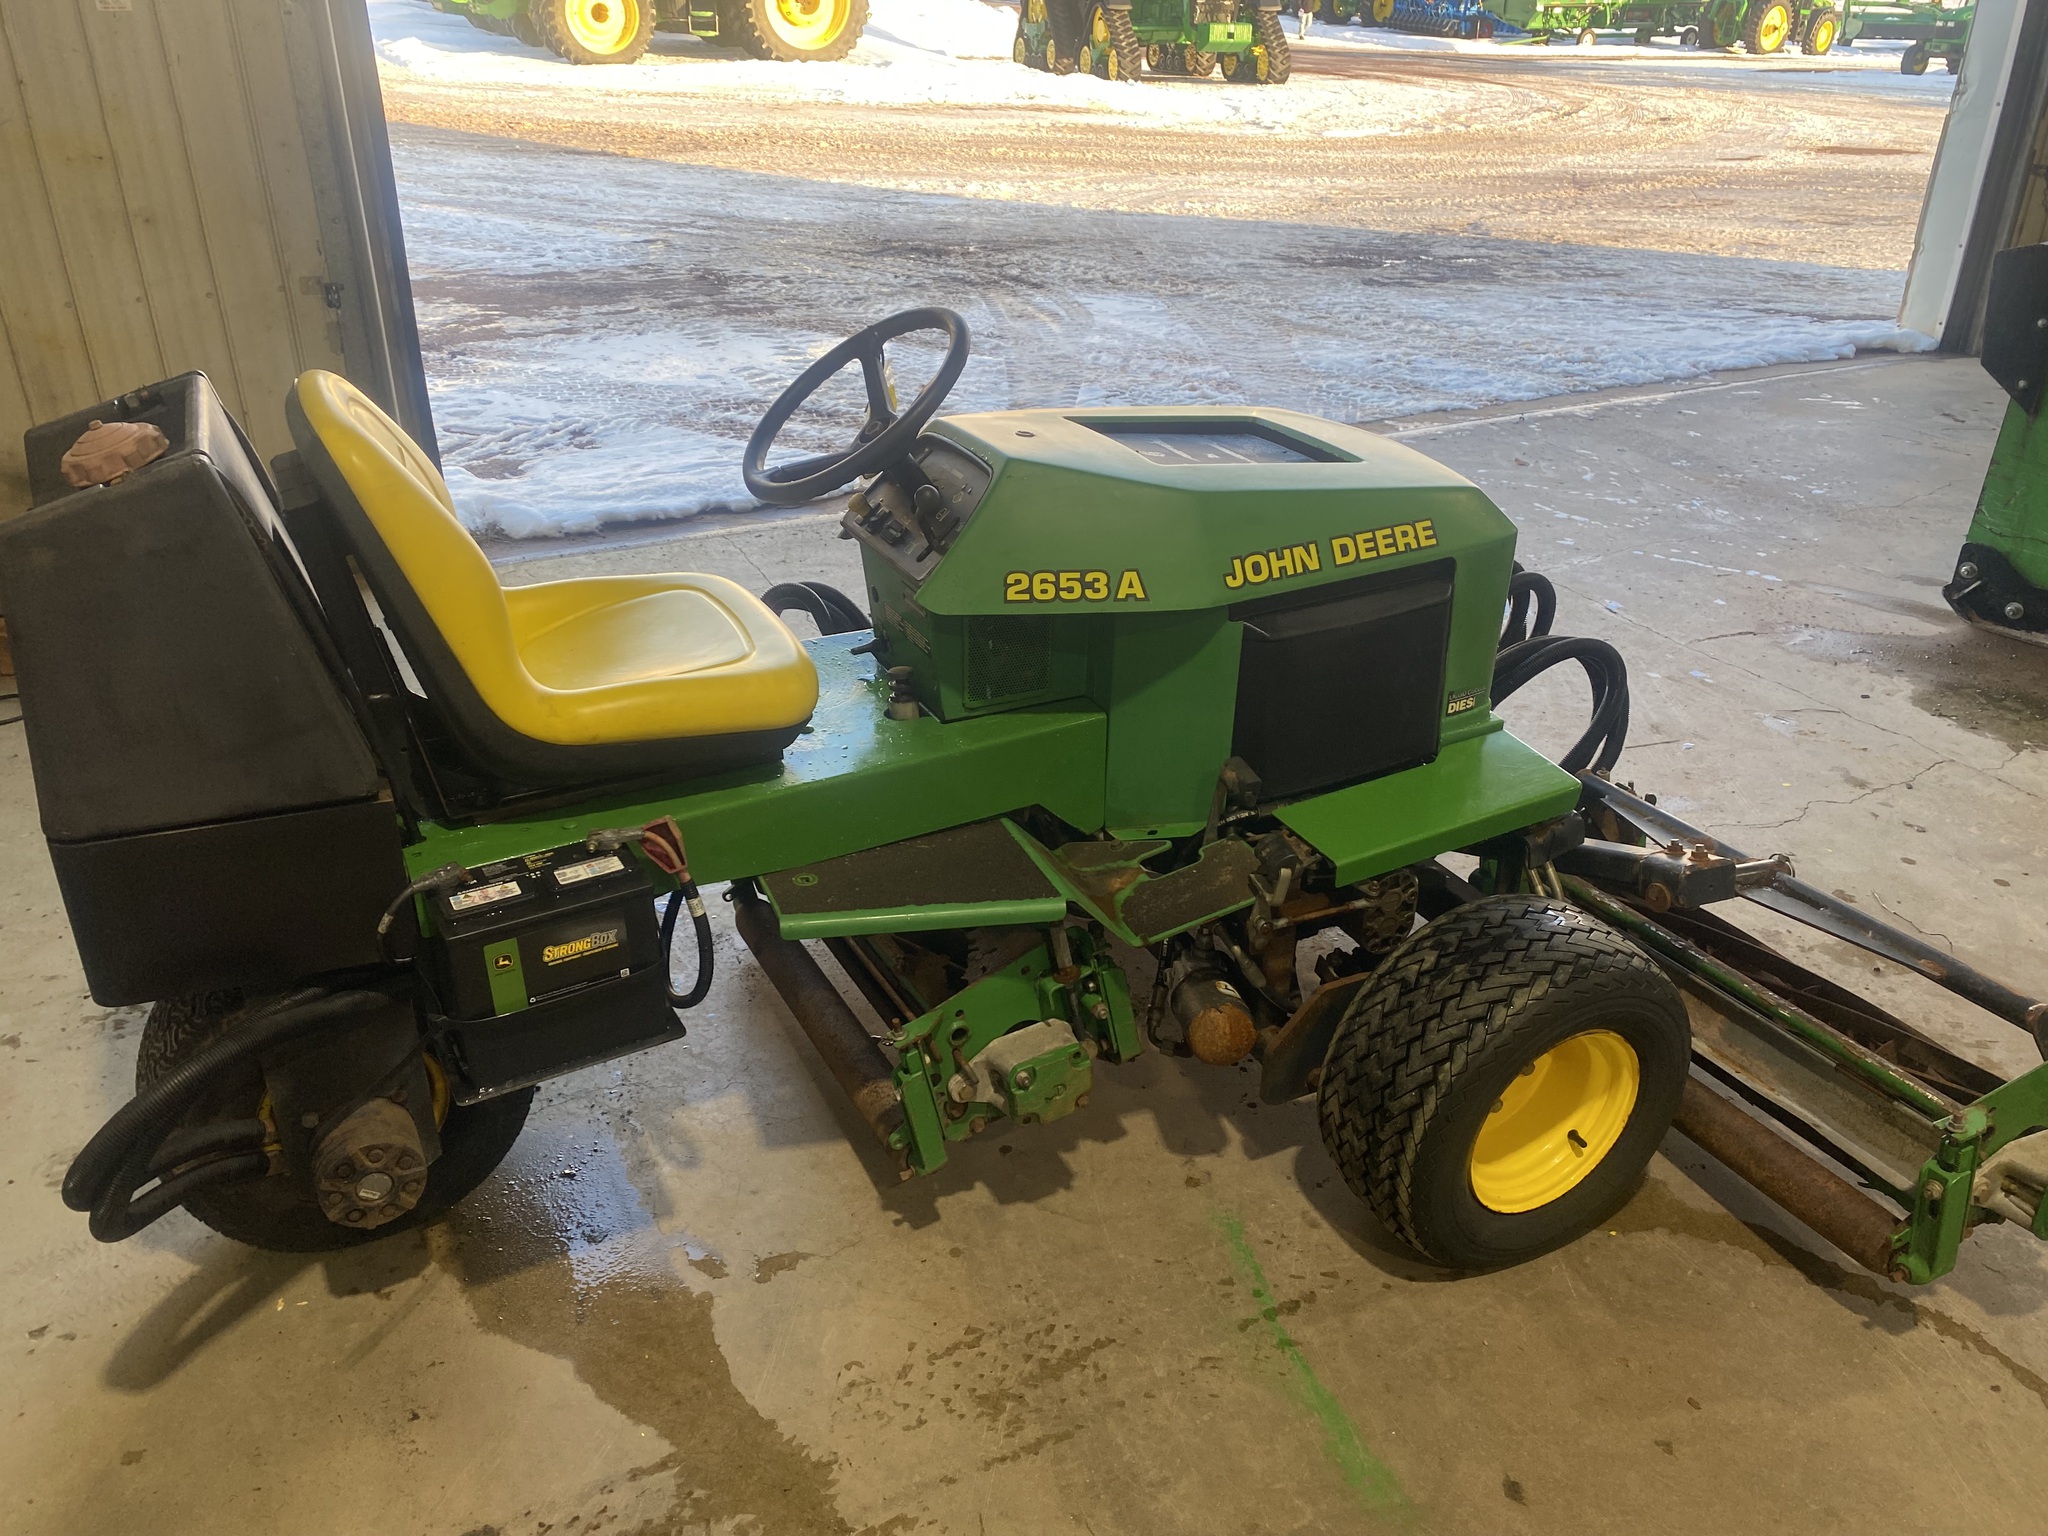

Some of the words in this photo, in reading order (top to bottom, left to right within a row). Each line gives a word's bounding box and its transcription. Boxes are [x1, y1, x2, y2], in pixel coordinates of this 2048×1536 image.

[1223, 541, 1321, 588] JOHN
[1330, 519, 1438, 567] DEERE
[1447, 695, 1475, 714] DIES
